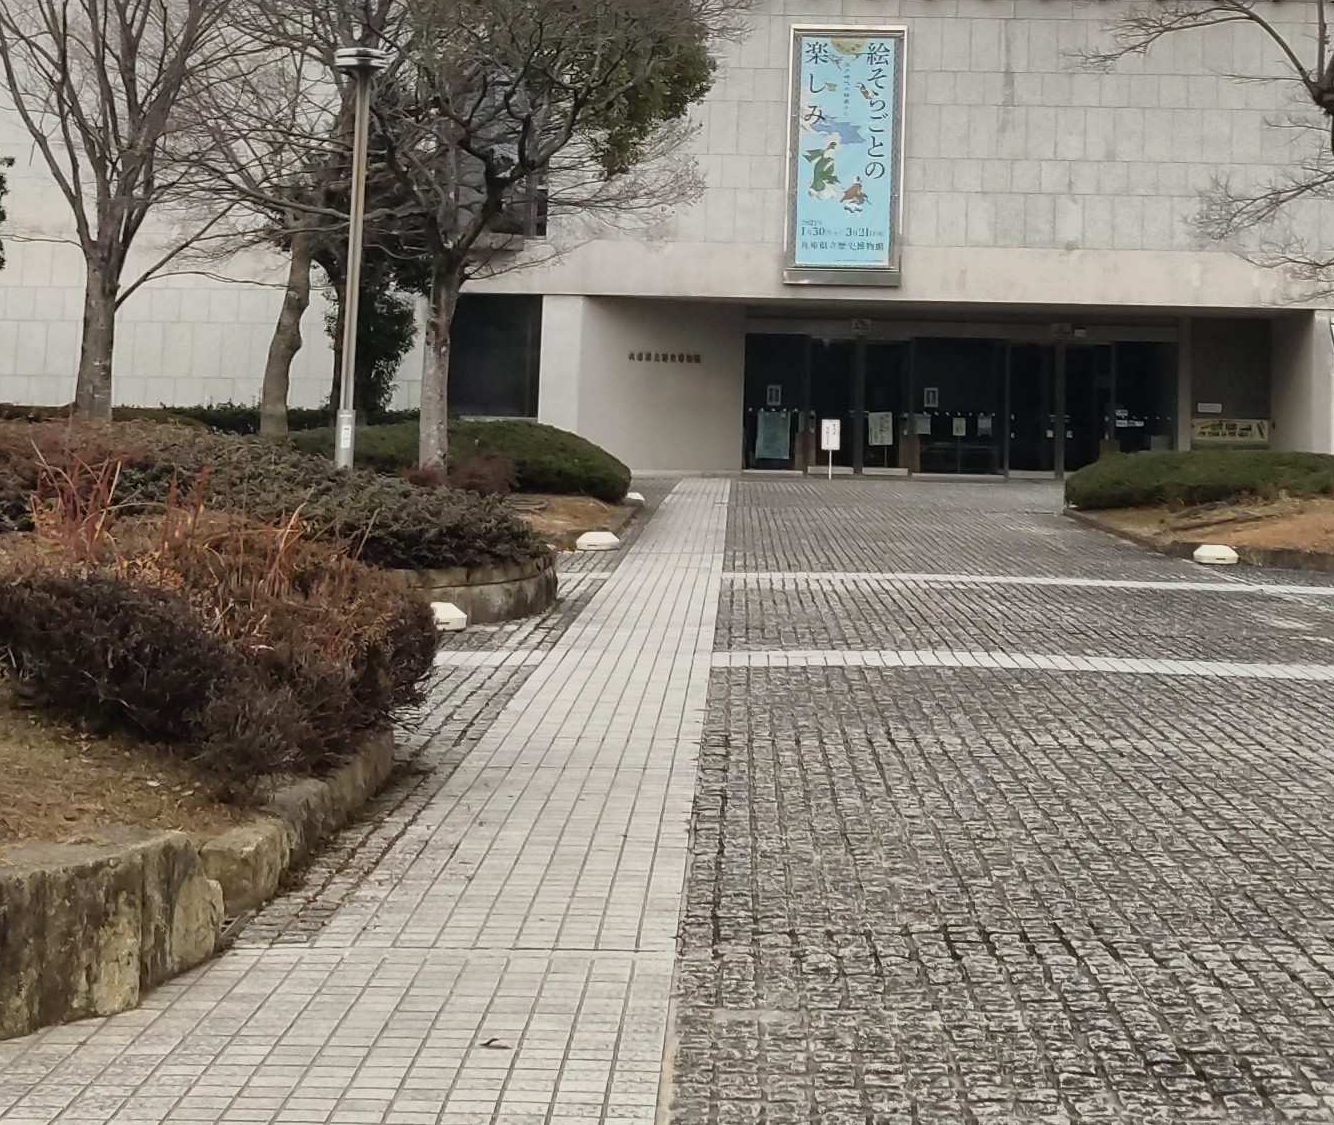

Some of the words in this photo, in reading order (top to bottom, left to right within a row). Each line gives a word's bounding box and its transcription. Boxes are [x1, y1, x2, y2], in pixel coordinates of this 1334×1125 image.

[803, 41, 828, 125] 楽しみ
[865, 42, 890, 179] 絵そらごとの
